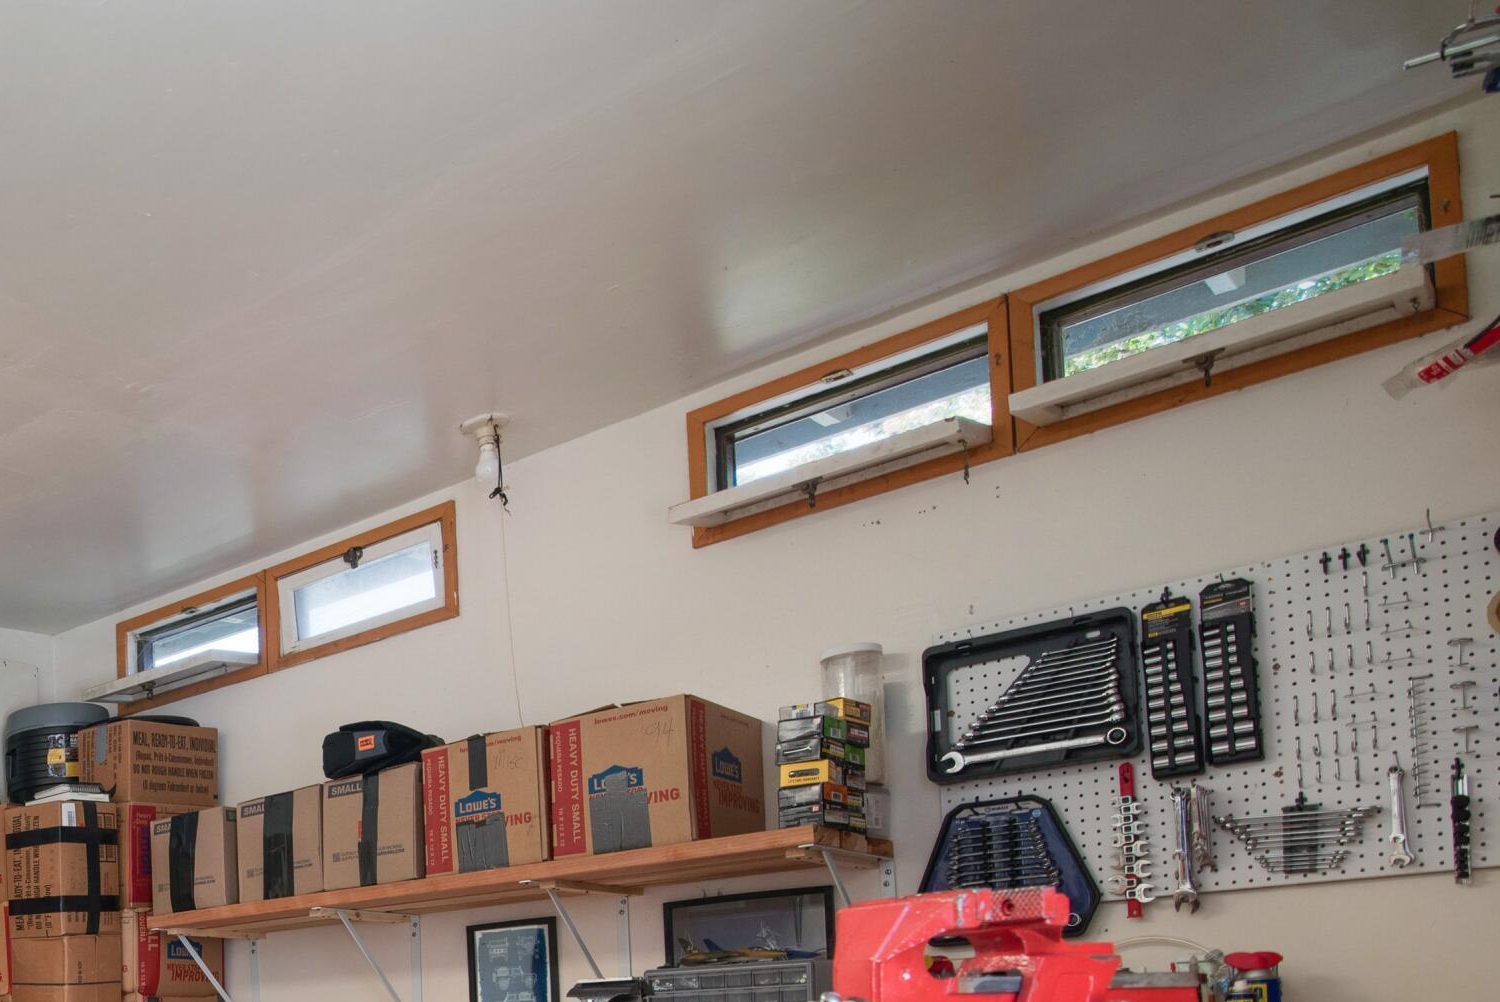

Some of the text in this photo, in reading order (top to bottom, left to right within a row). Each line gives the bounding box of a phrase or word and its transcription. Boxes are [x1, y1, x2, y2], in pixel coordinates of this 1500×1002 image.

[594, 704, 668, 725] lowes.com/moving
[189, 735, 216, 754] INDIVIDUAL
[331, 784, 361, 795] SMALL
[568, 728, 581, 843] HEAVY DUTY SMALL
[593, 771, 637, 791] LO'S
[437, 756, 449, 863] HEAVY DUTY SMALL
[459, 797, 497, 814] LOWE'S
